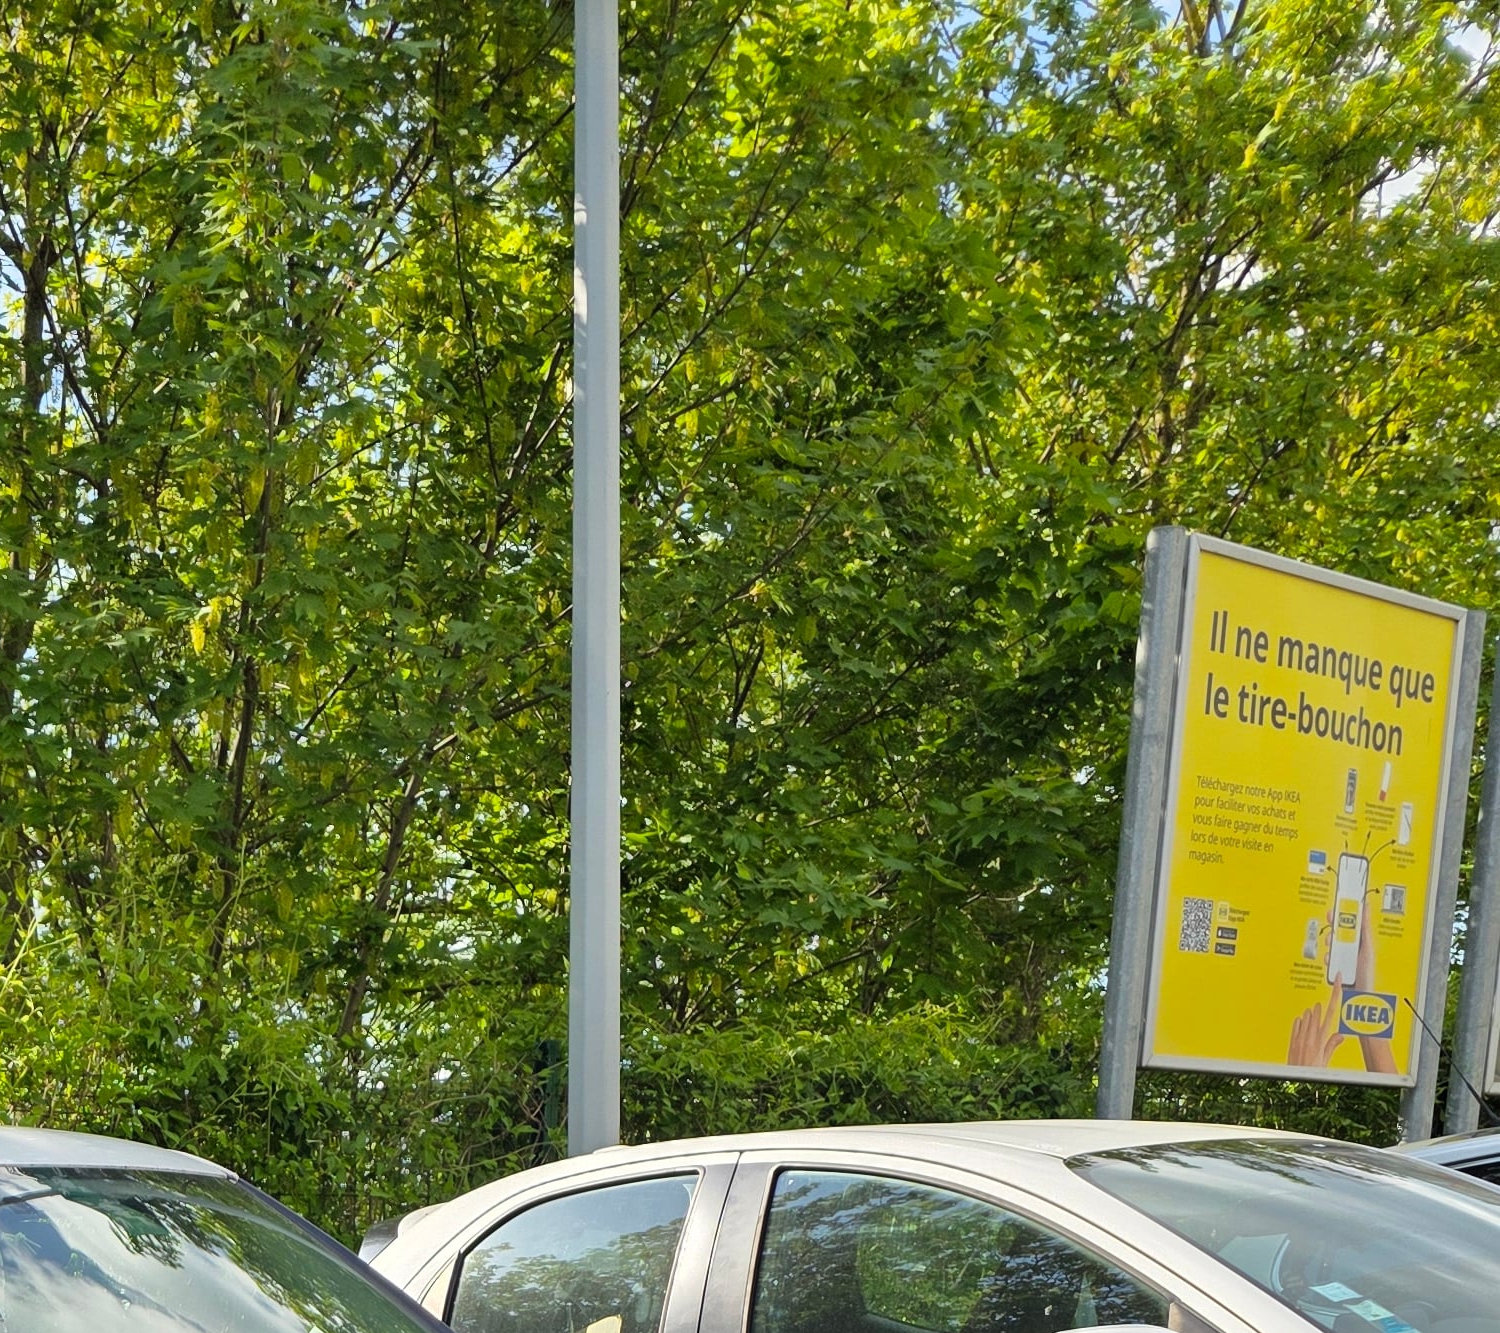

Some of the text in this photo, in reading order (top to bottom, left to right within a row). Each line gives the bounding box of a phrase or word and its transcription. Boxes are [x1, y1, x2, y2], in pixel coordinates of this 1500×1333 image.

[1210, 610, 1435, 708] Il ne manque que
[1205, 672, 1403, 755] le tire-bouchon
[1197, 775, 1301, 804] Téléchargez notre App IKEA
[1194, 796, 1296, 821] pour faciliter vos achats et
[1192, 814, 1299, 841] vous faire gagner du temps
[1190, 829, 1274, 853] lors de votre visite en
[1188, 849, 1224, 865] magasin.
[1345, 1004, 1390, 1025] IKEA
